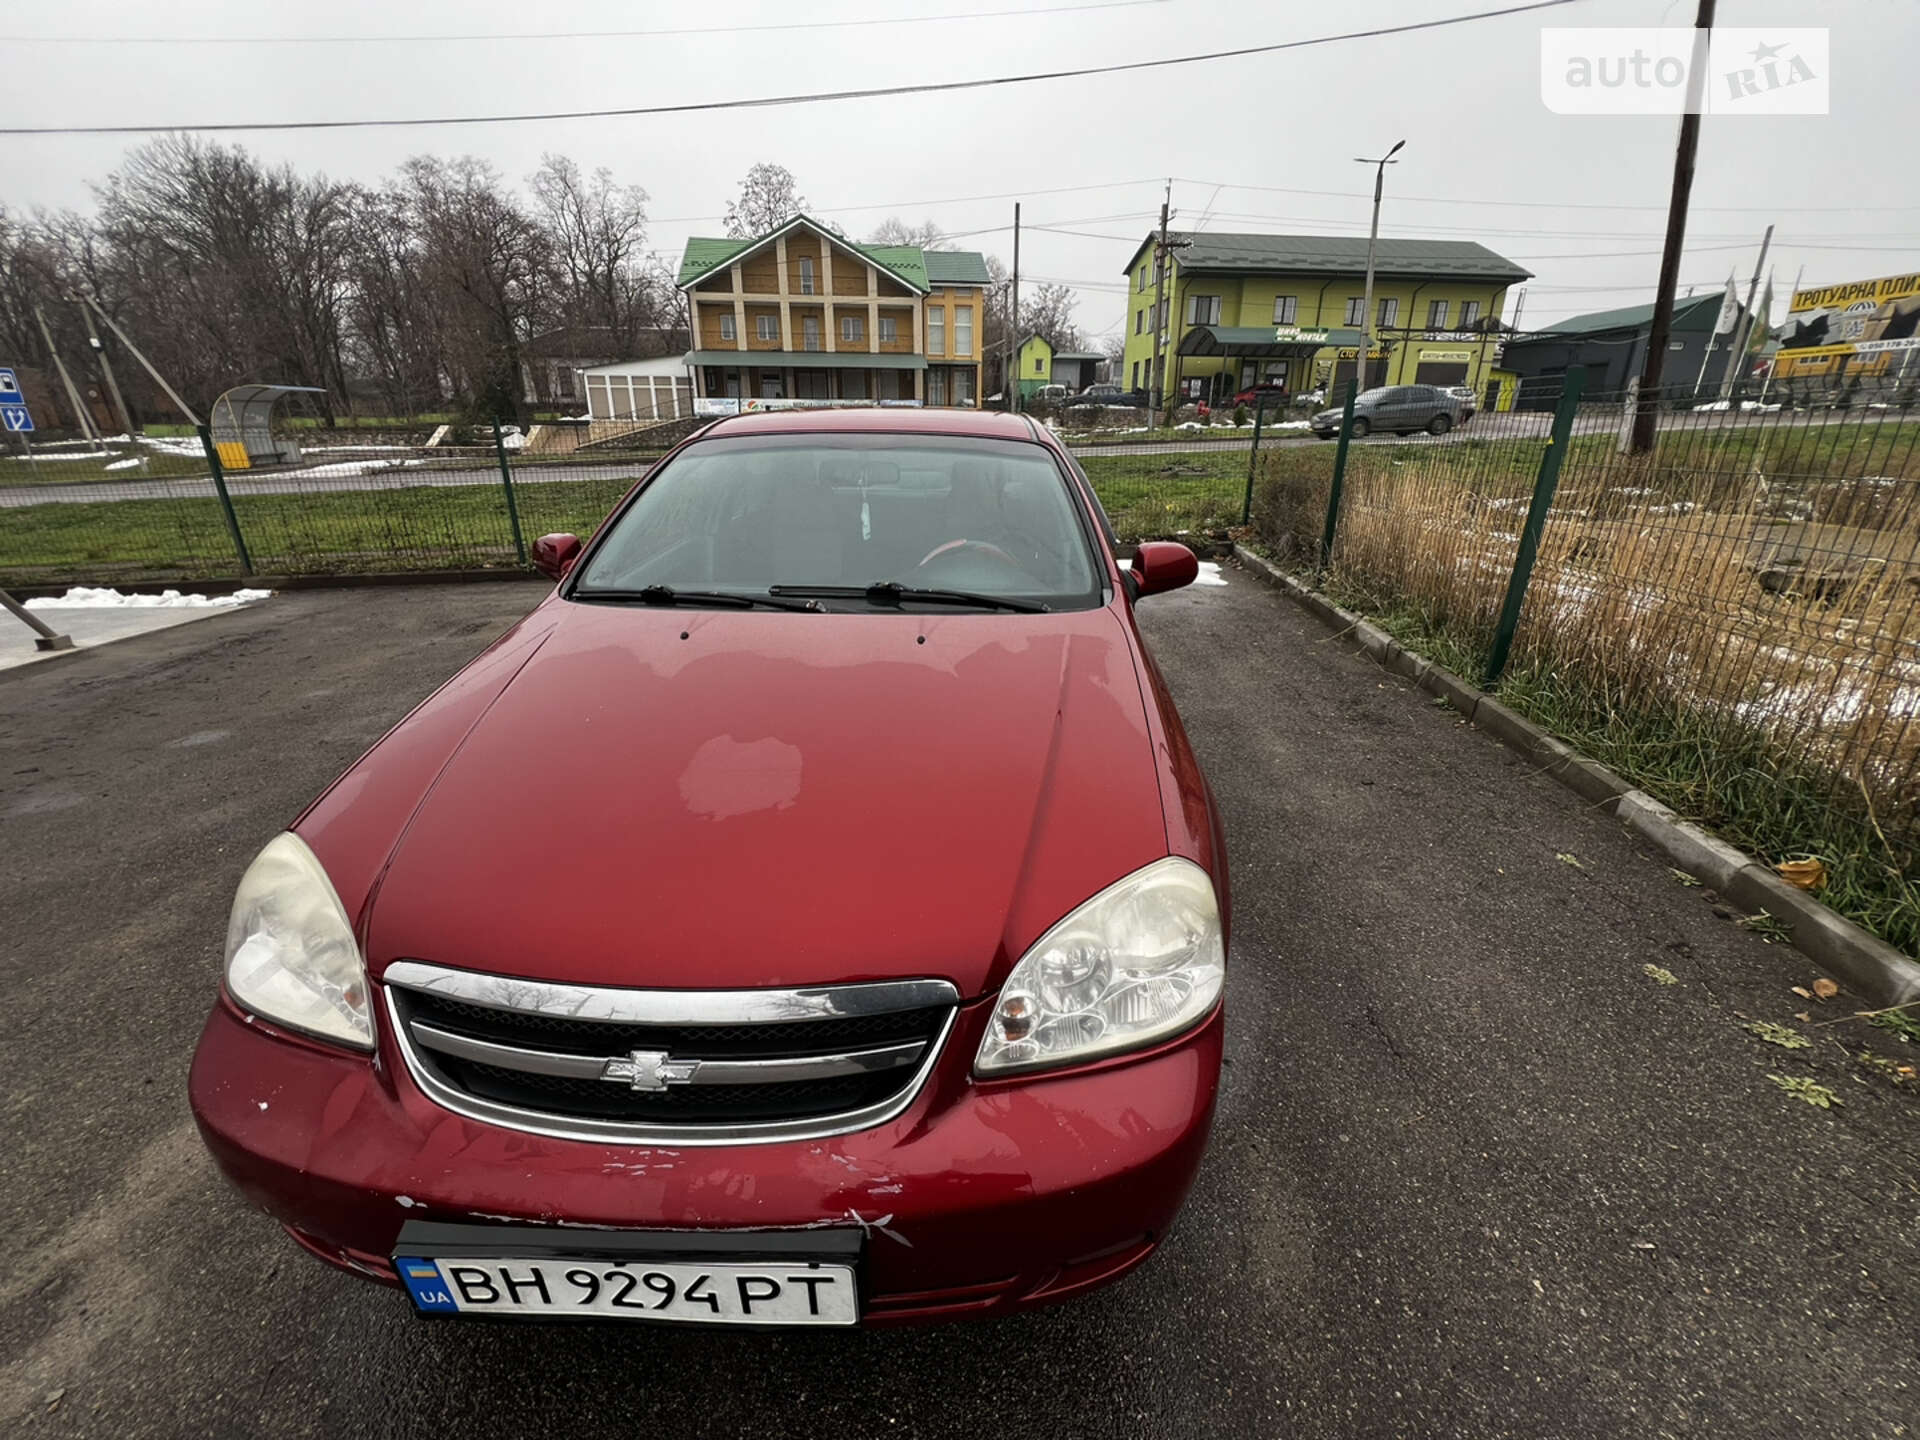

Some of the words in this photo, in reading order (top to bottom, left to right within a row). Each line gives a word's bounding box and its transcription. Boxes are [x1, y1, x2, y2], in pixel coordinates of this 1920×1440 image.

[1796, 282, 1877, 306] ТРОТУАРНА
[1880, 275, 1920, 295] ПЛИ
[419, 1291, 451, 1304] UA
[450, 1267, 552, 1306] BH
[565, 1270, 720, 1313] 9294
[737, 1275, 834, 1315] PT
